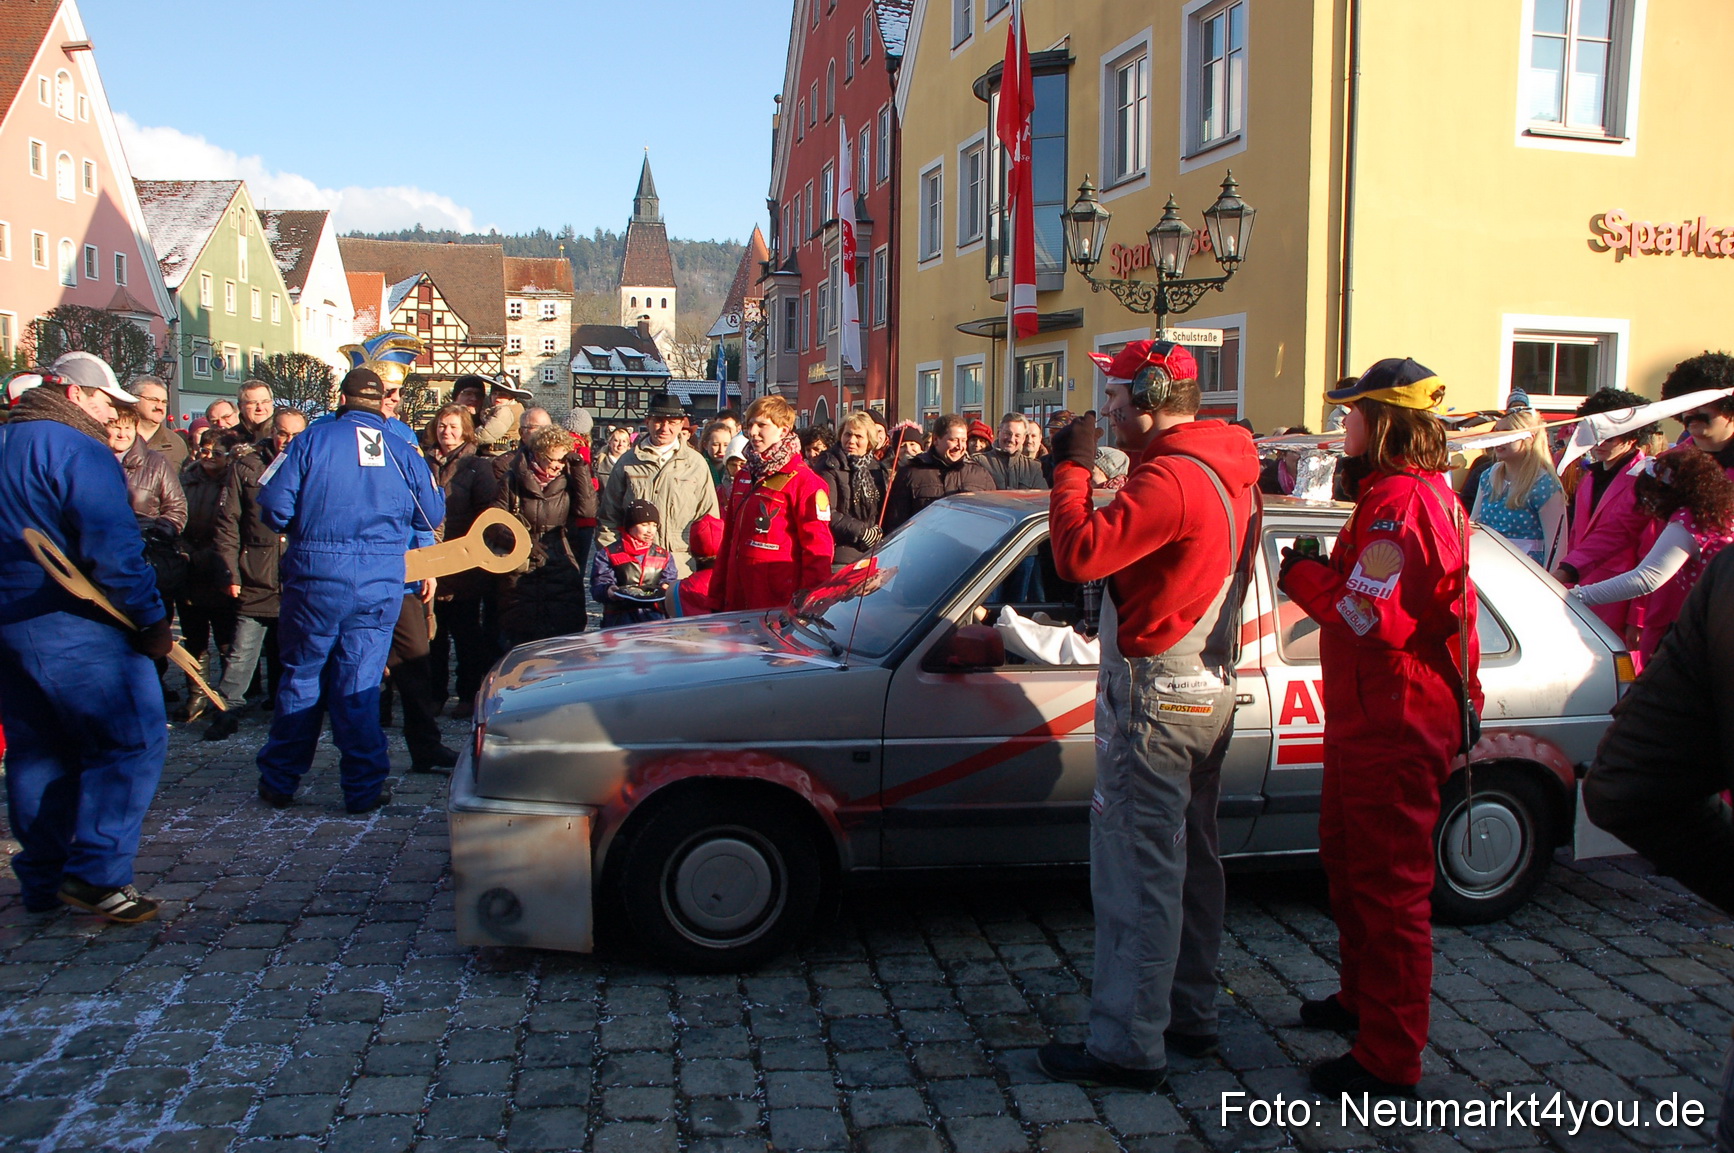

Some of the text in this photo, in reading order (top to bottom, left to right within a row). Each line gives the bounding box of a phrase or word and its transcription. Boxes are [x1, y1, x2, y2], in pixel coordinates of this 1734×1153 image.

[1172, 331, 1218, 342] Schulstraße
[1346, 578, 1392, 599] Shell
[1338, 600, 1367, 631] Red Bull
[1190, 680, 1208, 688] ultra
